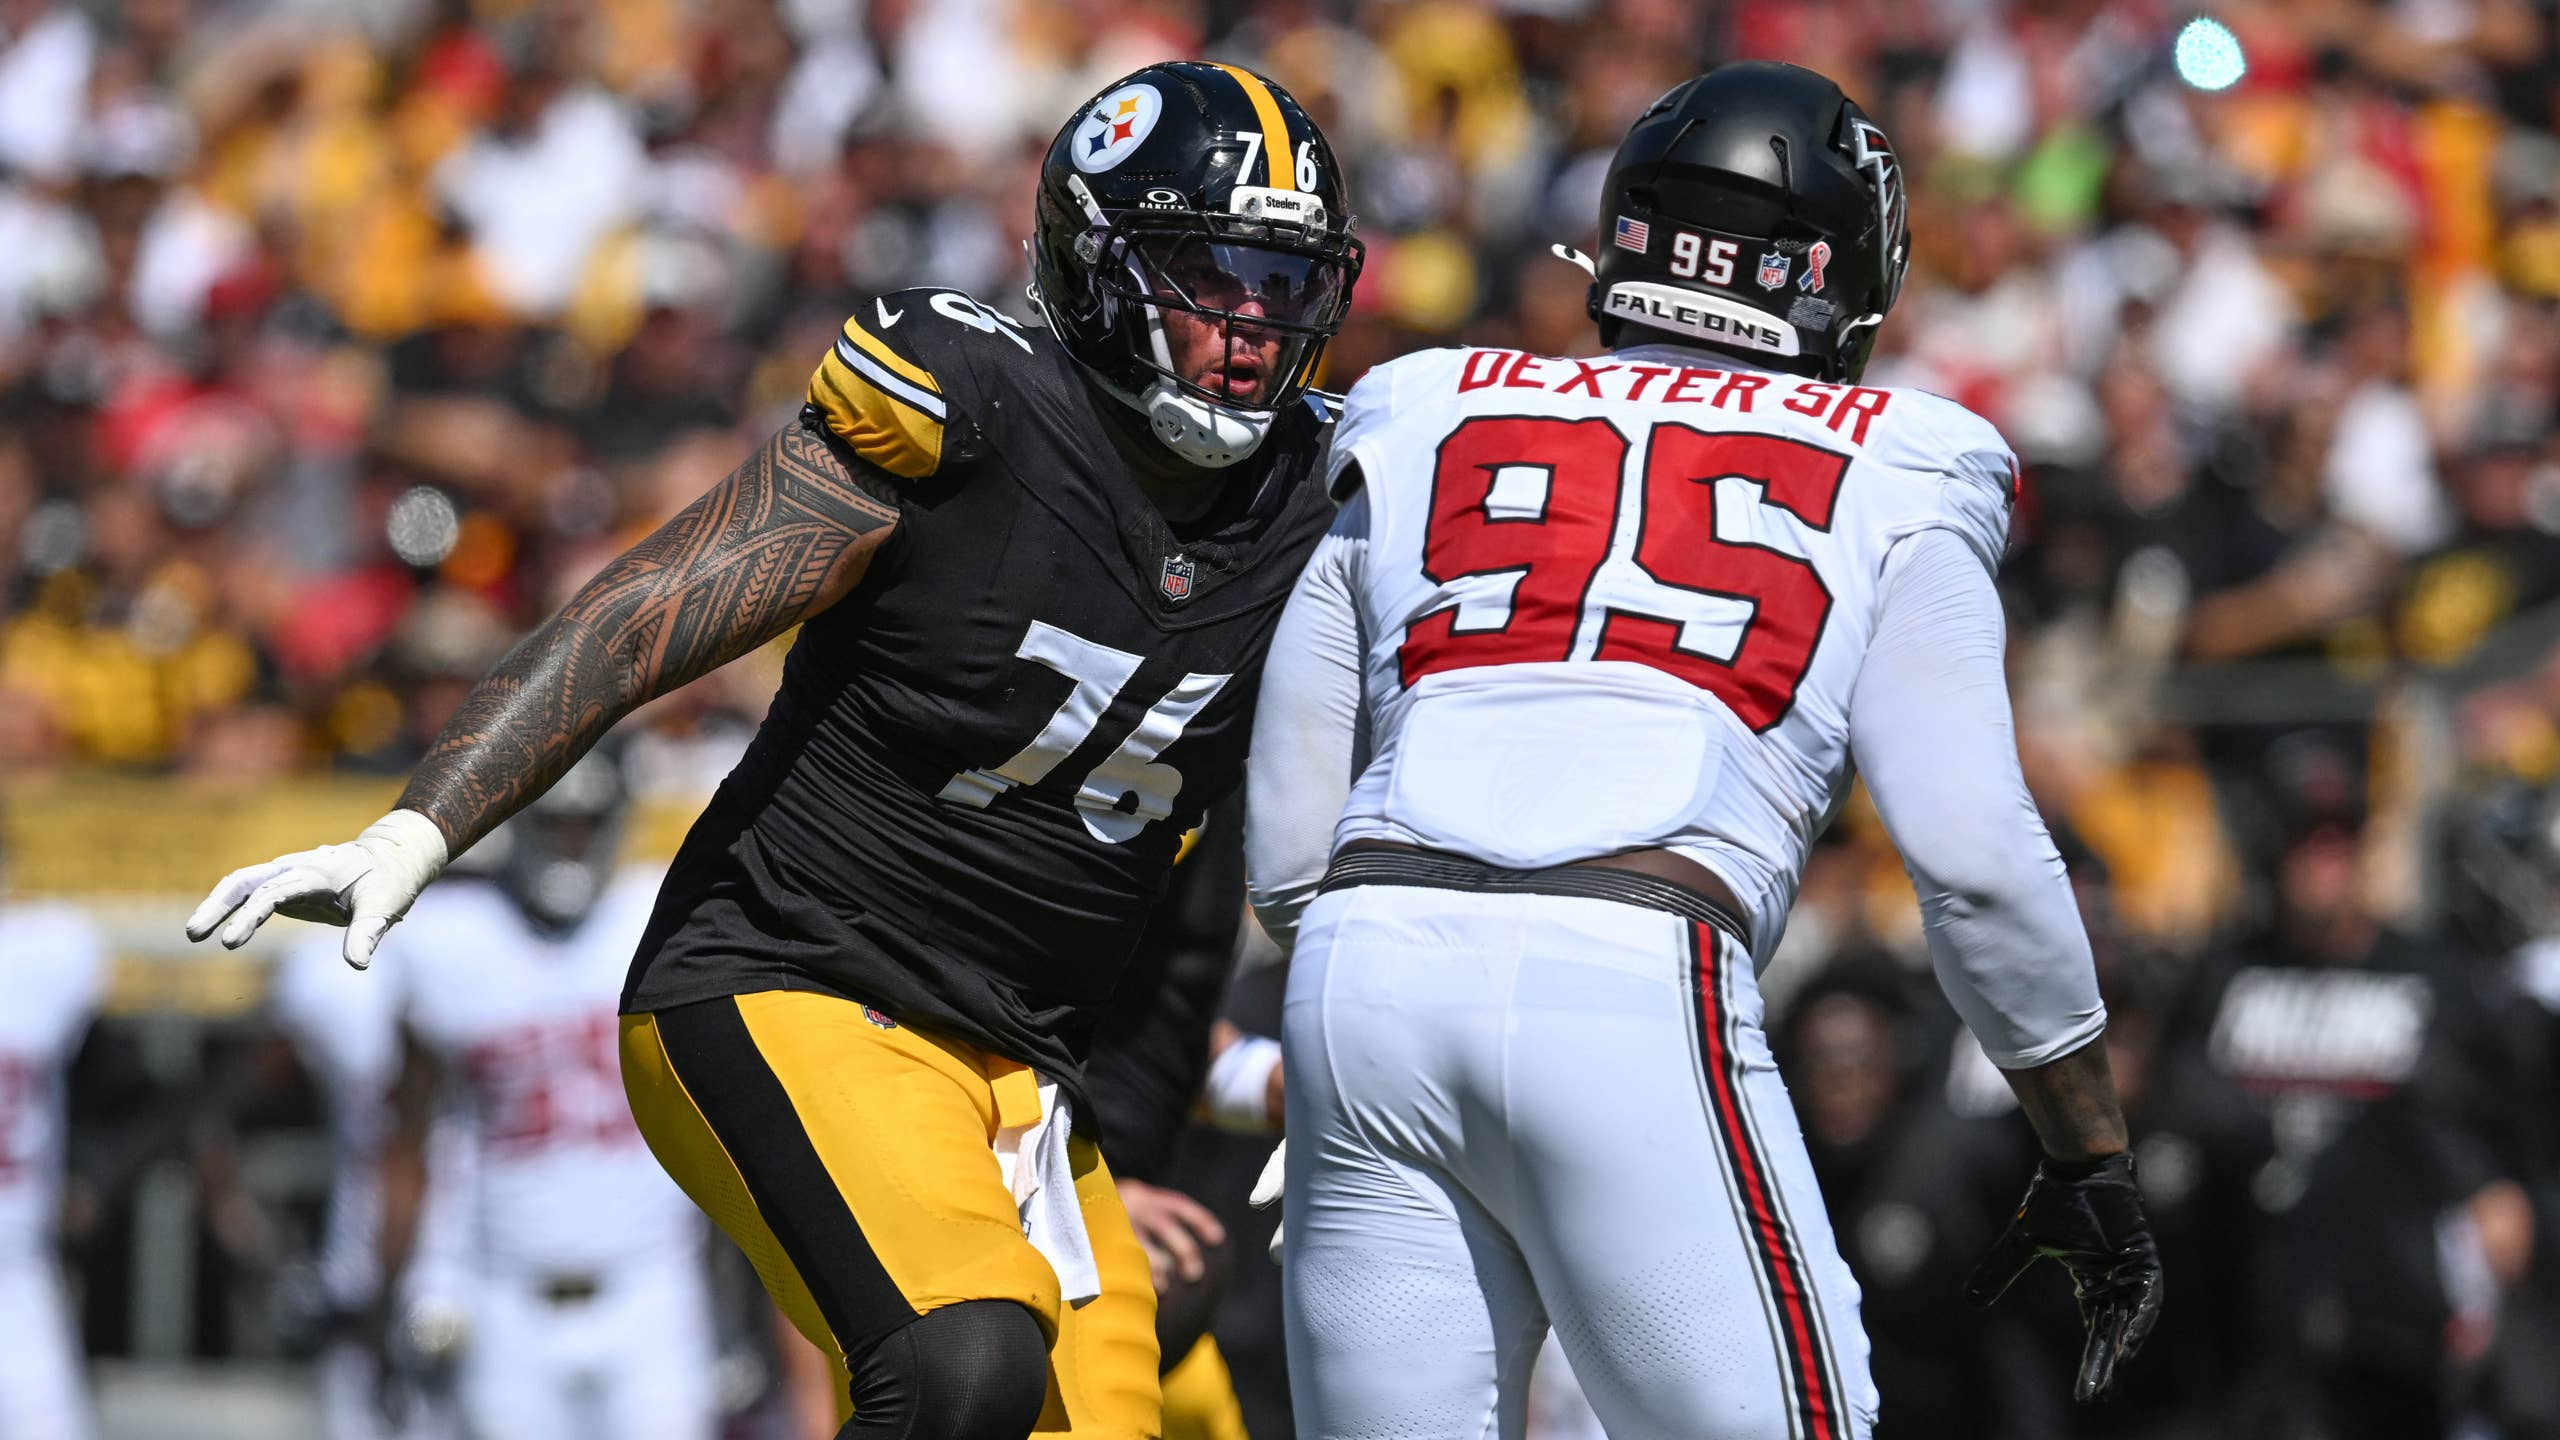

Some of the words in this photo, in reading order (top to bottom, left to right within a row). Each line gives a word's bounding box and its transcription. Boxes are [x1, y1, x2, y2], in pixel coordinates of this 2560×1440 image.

[1266, 195, 1301, 211] Steelers
[1669, 231, 1738, 286] 95
[1762, 267, 1783, 285] NFL
[1611, 292, 1781, 338] FALCONS
[1458, 350, 1771, 413] DEXTER
[1782, 382, 1891, 448] SR
[1164, 575, 1188, 595] NFL
[1398, 414, 1854, 735] 95
[935, 619, 1234, 844] 76
